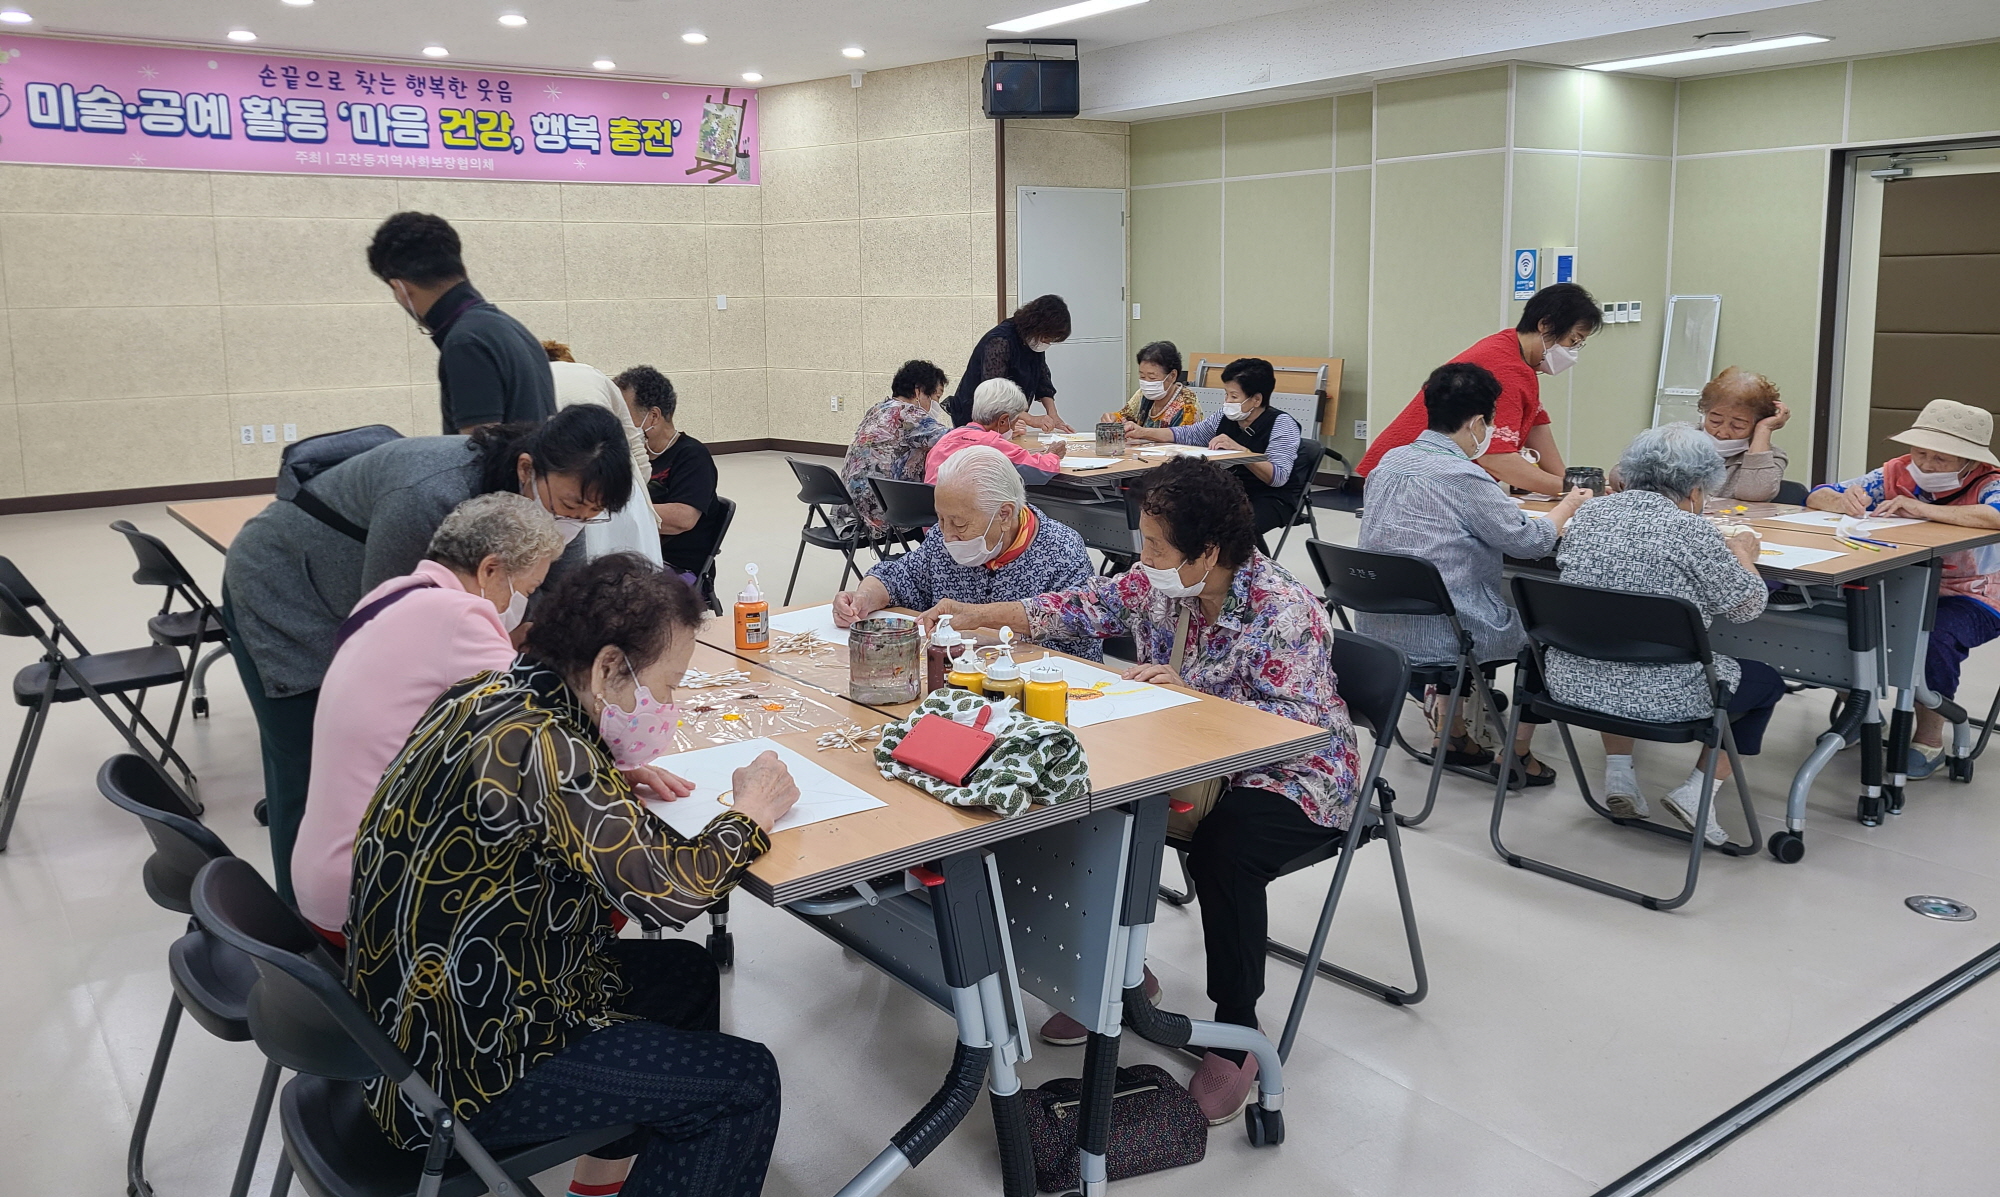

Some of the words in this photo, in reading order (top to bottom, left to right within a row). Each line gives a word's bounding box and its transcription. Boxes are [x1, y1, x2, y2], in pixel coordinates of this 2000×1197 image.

[258, 64, 345, 91] 손끝으로
[355, 70, 396, 95] 찾는
[405, 74, 468, 101] 행복한
[477, 78, 513, 104] 웃음
[26, 82, 232, 140] 미술·공예
[240, 95, 328, 144] 활동
[439, 107, 524, 155] 건강,
[530, 112, 601, 155] 행복
[295, 151, 322, 165] 주최
[334, 152, 494, 171] 고잔동지역사회보장협의체
